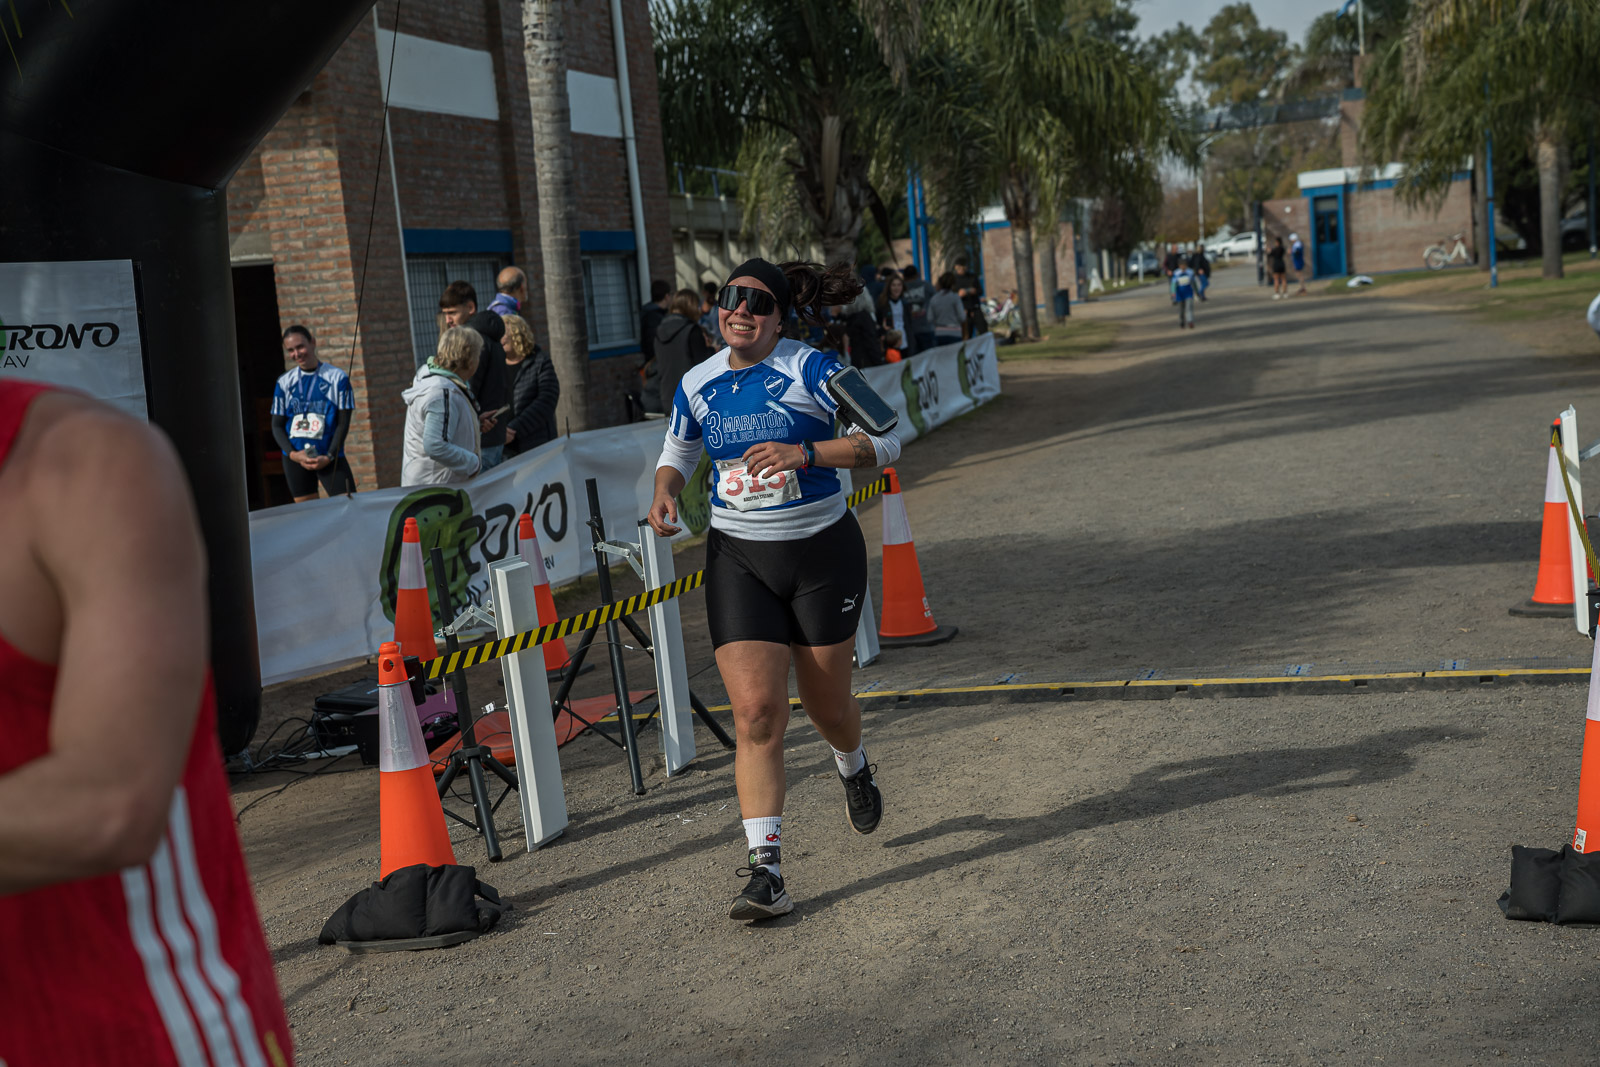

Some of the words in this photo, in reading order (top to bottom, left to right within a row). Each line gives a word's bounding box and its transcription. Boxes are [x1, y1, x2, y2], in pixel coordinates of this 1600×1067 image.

[0, 322, 120, 351] RONO
[0, 355, 30, 368] AV
[706, 410, 724, 449] 3
[722, 409, 787, 434] MARATÓN
